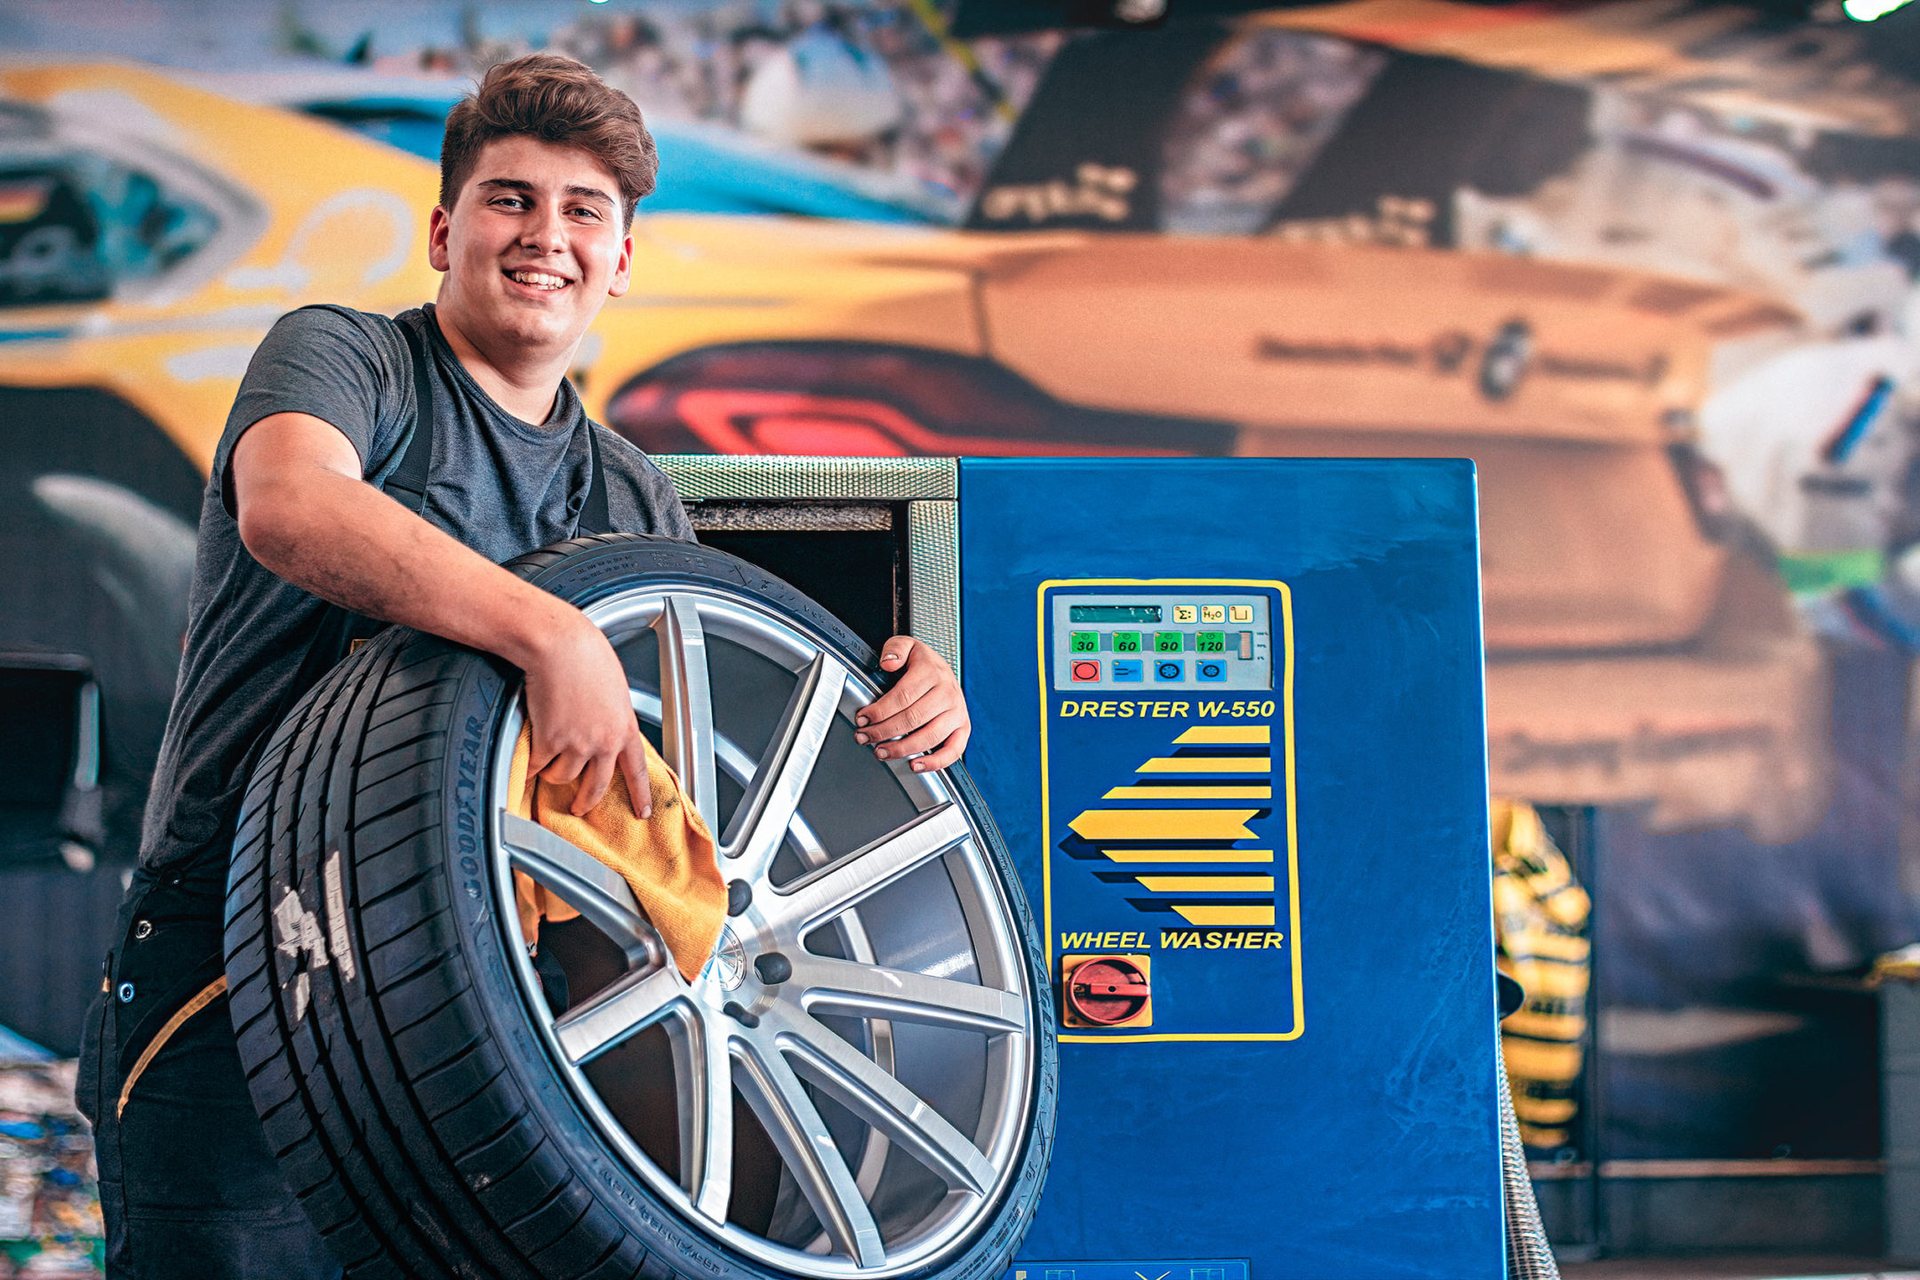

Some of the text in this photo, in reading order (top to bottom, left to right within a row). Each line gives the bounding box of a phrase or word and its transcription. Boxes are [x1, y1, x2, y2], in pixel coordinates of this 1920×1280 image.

[1076, 641, 1095, 651] 30
[1118, 641, 1137, 651] 60
[1160, 641, 1179, 651] 90
[1200, 641, 1223, 651] 120
[1060, 700, 1276, 718] DRESTER W-550
[456, 715, 485, 898] GOODYEAR
[1061, 931, 1284, 949] WHEEL WASHER
